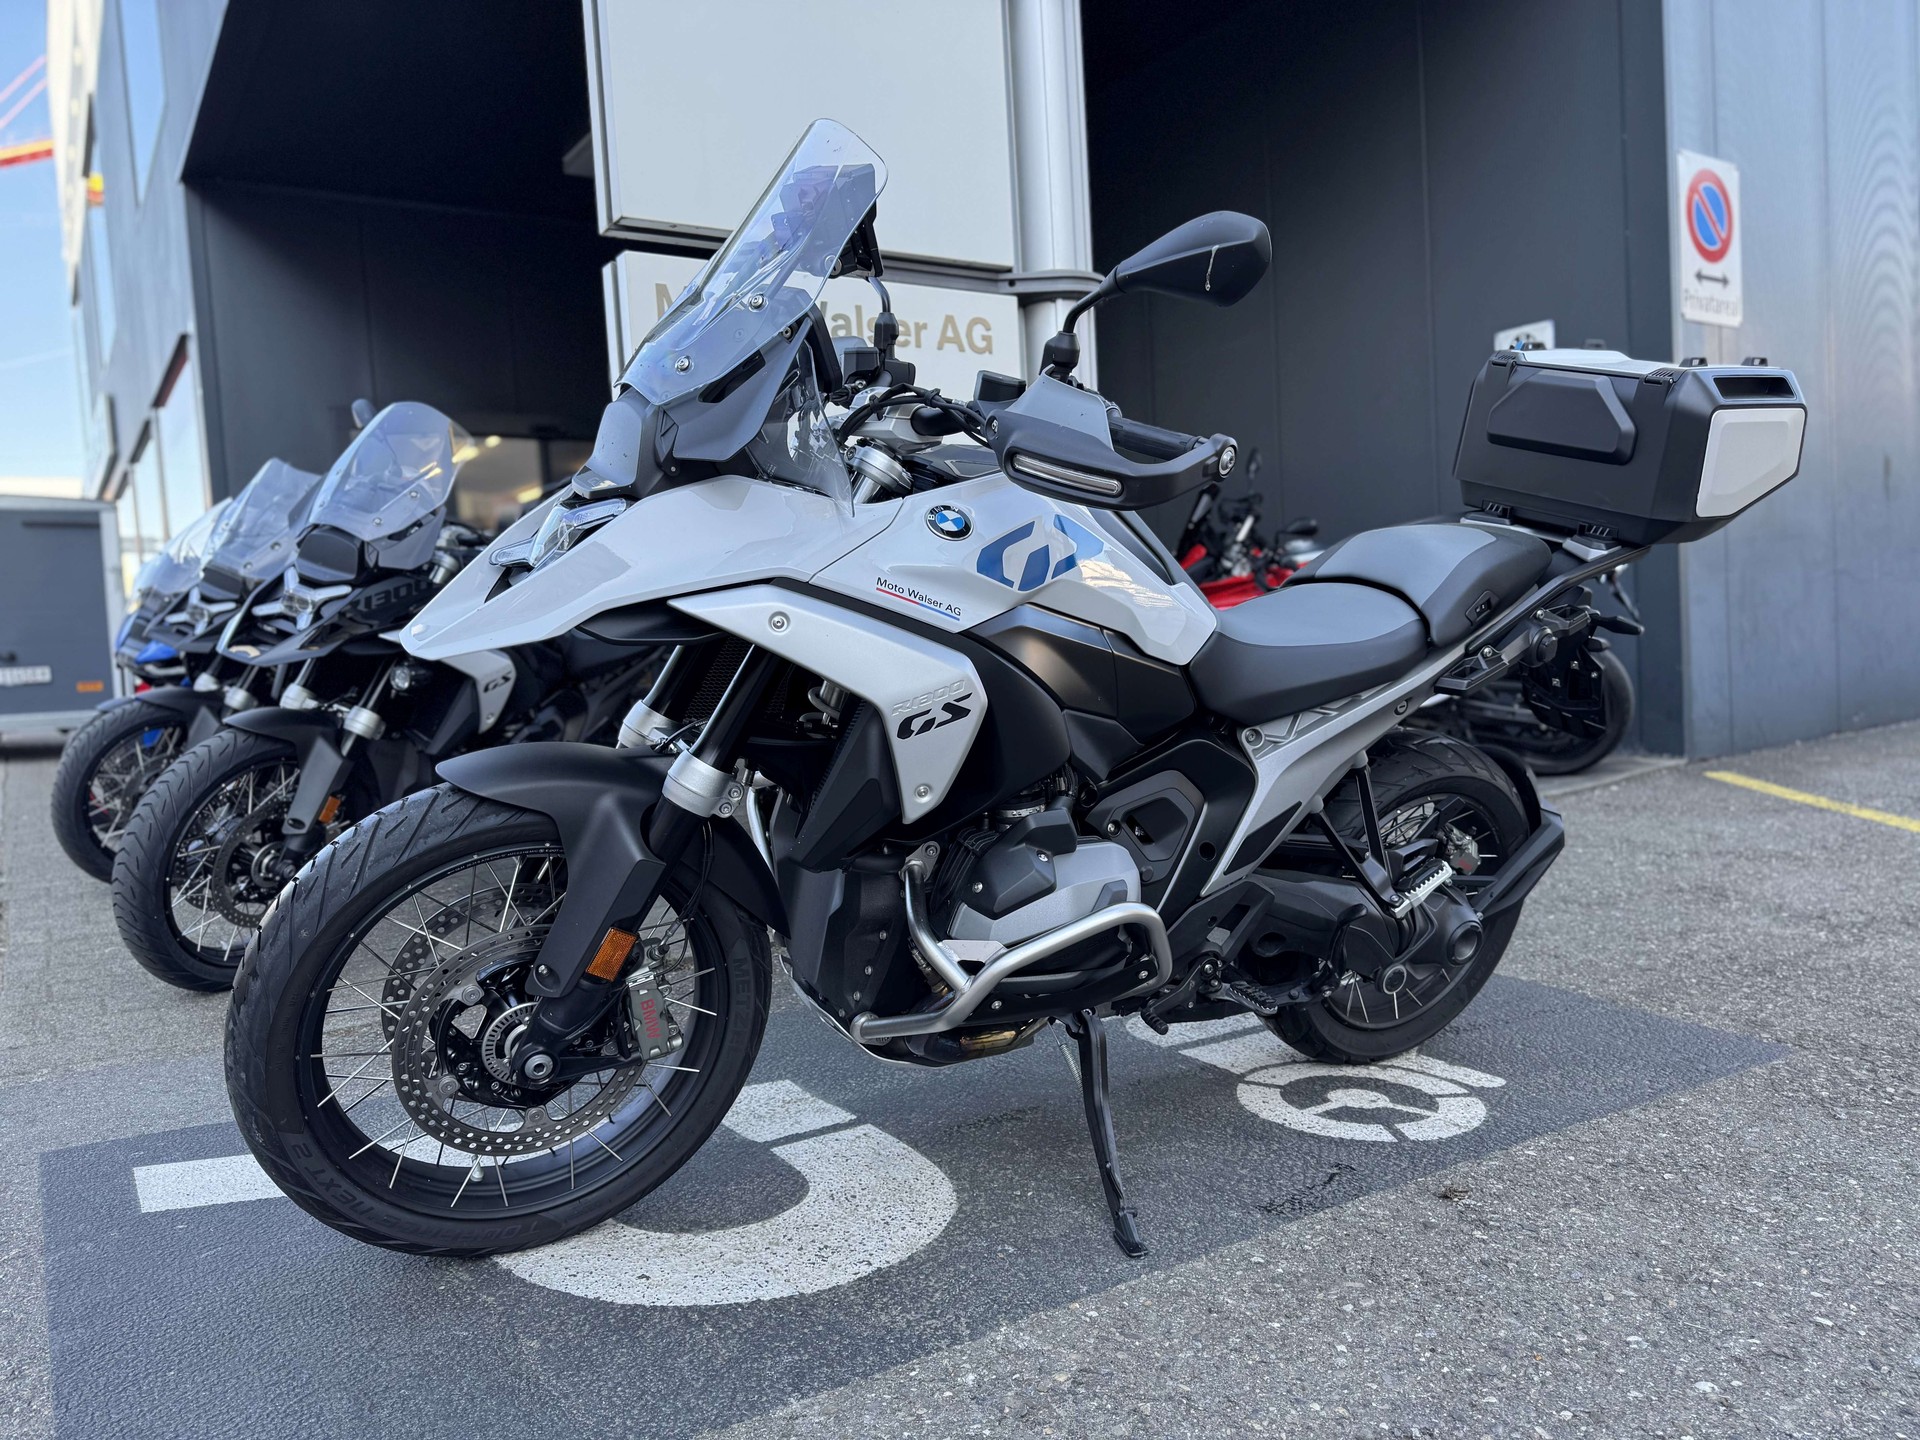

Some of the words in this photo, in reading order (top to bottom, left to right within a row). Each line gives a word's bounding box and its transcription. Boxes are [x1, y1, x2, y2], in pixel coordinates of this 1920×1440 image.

[820, 301, 928, 348] aler
[937, 314, 993, 355] AG
[877, 577, 904, 594] Moto
[907, 587, 943, 609] Walser
[945, 604, 961, 616] AG
[897, 692, 972, 740] GS
[640, 998, 663, 1039] BMW
[290, 1142, 314, 1159] 2
